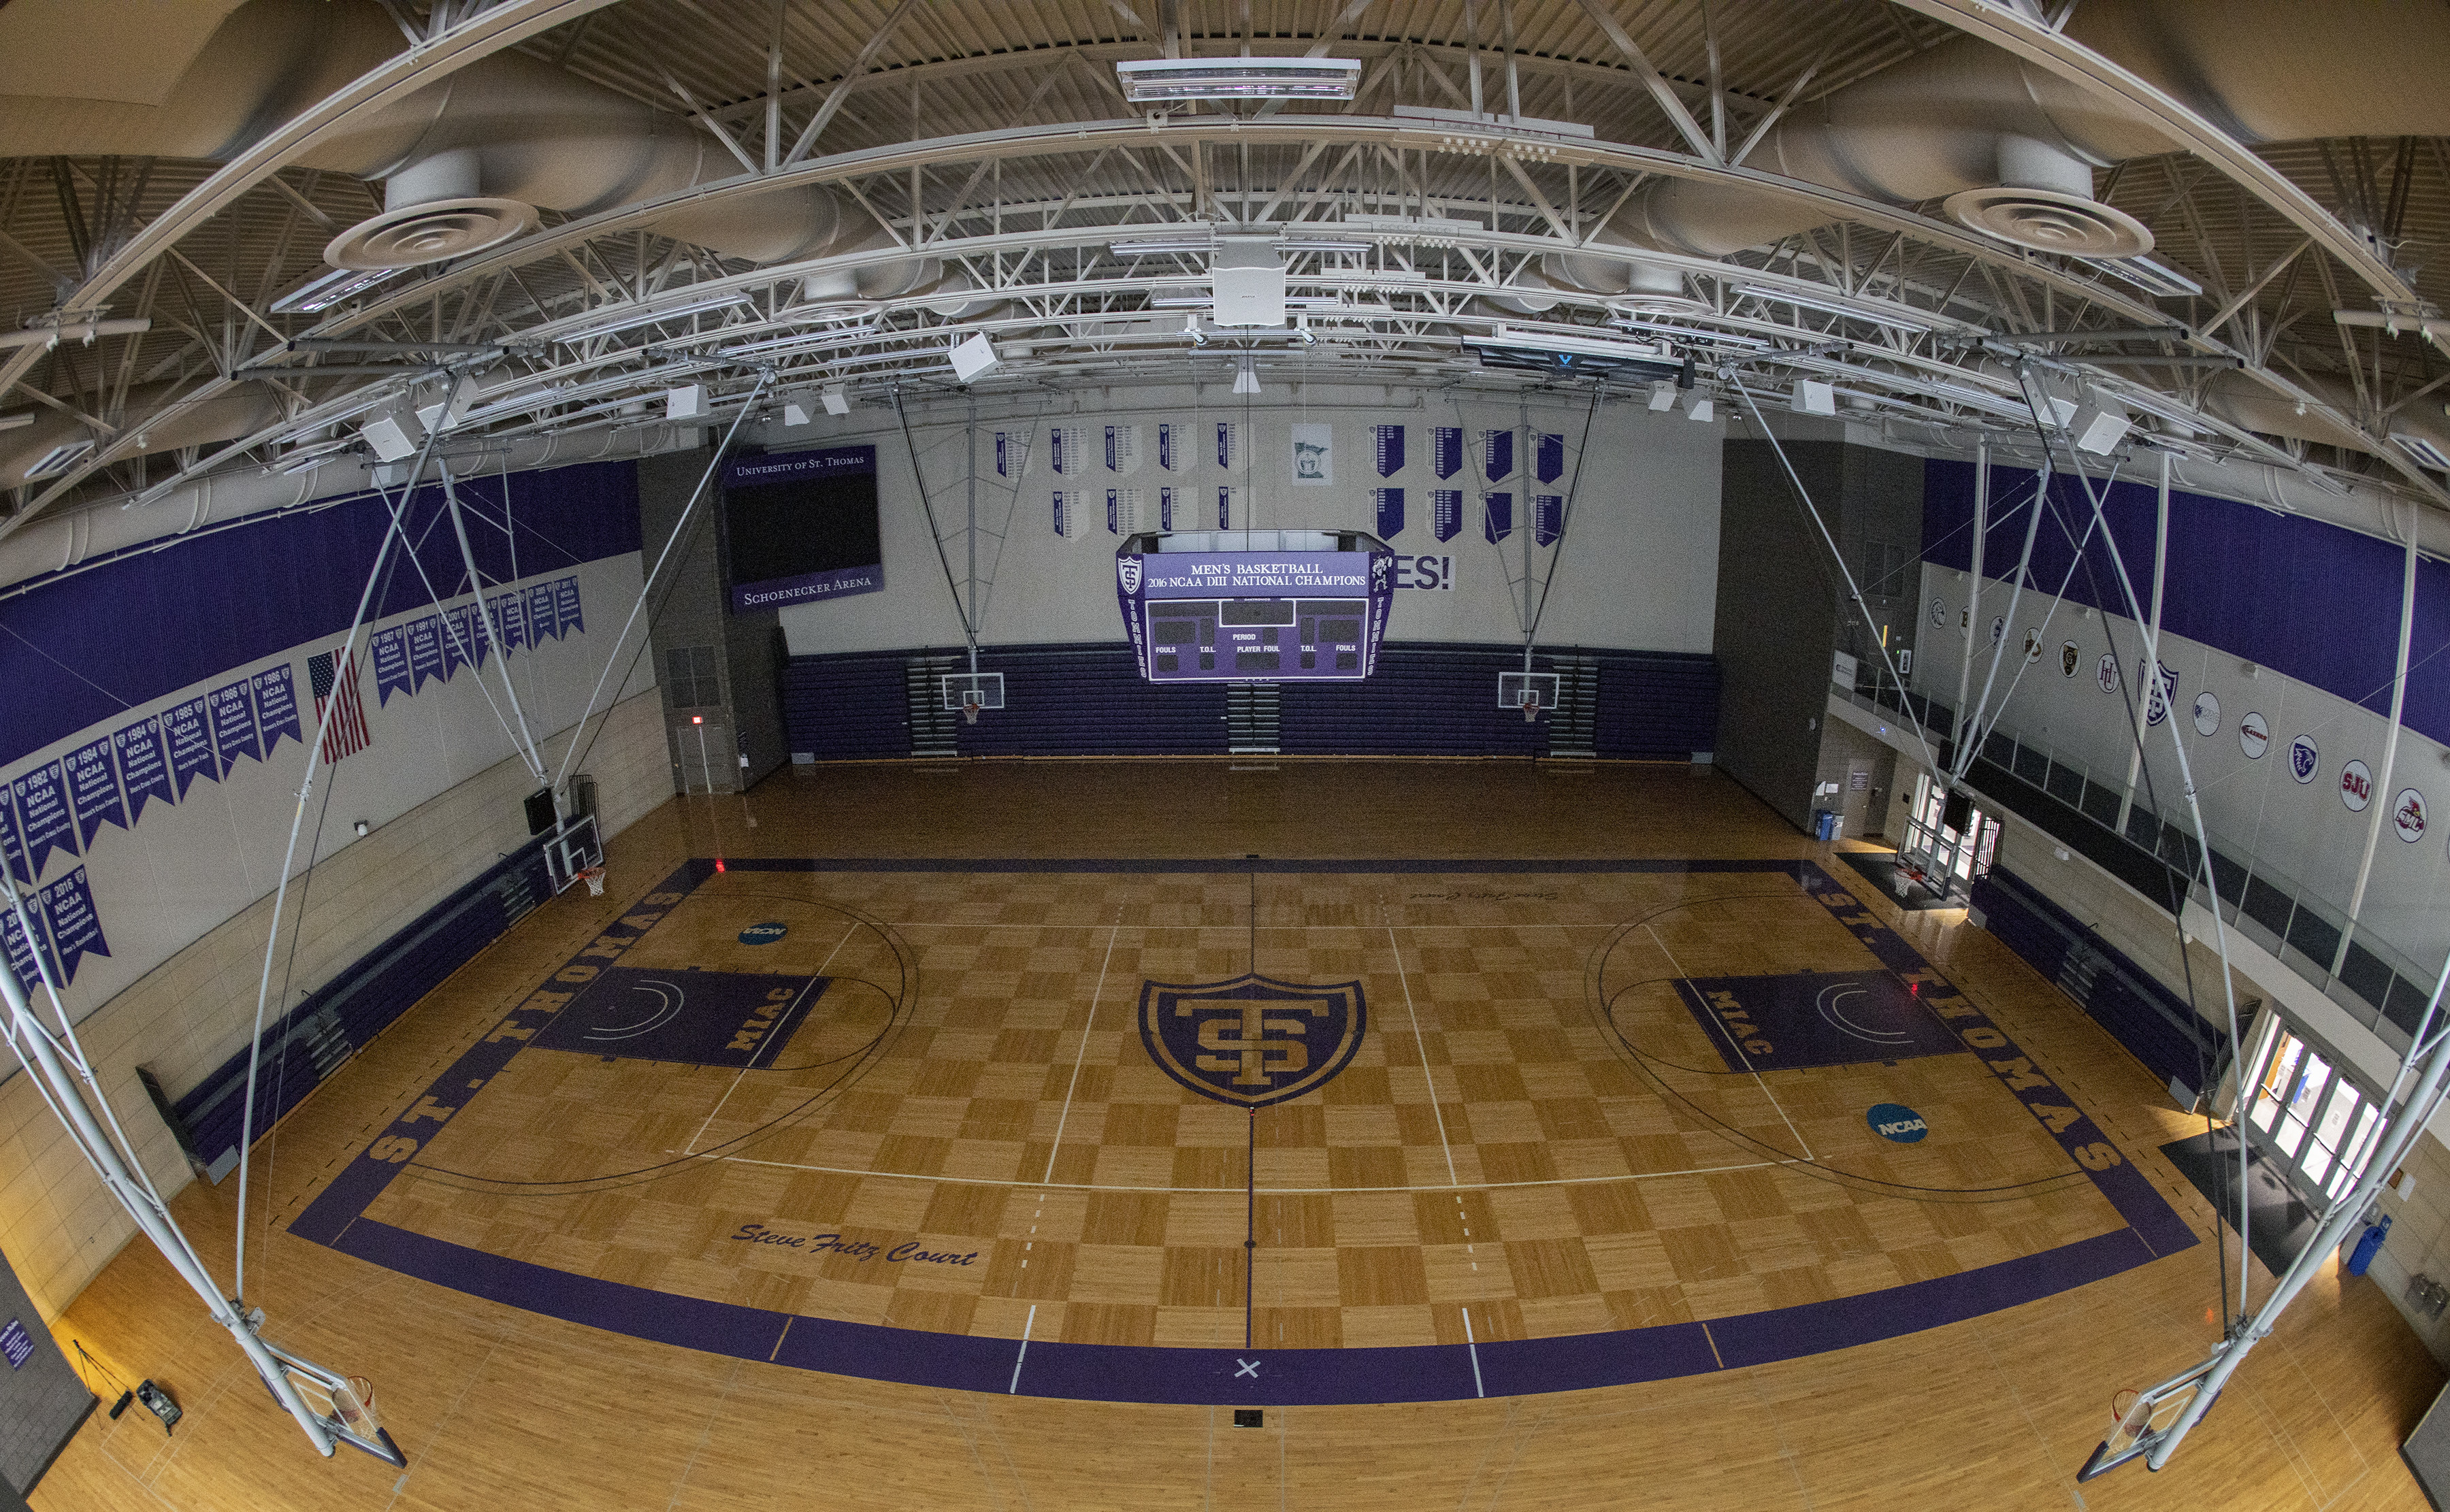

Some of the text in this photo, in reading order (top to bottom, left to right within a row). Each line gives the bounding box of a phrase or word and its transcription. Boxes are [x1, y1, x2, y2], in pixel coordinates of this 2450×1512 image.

[736, 464, 792, 476] UNIVERSITY
[809, 459, 823, 468] ST.
[826, 457, 864, 466] THOMAS
[1191, 564, 1323, 575] MEN'S BASKETBALL
[1148, 576, 1366, 587] 2016 NCAA DIII NATIONAL CHAMPIONS
[534, 595, 549, 605] NCAA
[744, 578, 872, 605] SCHOENECKER ARENA
[414, 632, 433, 644] NCAA
[1128, 599, 1147, 678] TOMMIES
[1367, 597, 1384, 675] TOMMIES
[379, 643, 399, 655] NCAA
[413, 649, 438, 660] Champions
[415, 641, 434, 651] National
[378, 660, 405, 673] Champions
[380, 652, 400, 663] National
[264, 671, 280, 686] 1986
[220, 687, 238, 702] 1986
[262, 684, 286, 700] NCAA
[264, 693, 288, 708] National
[175, 704, 193, 721] 1985
[219, 700, 244, 717] NCAA
[221, 710, 246, 726] National
[262, 703, 293, 719] Champions
[127, 725, 146, 742] 1984
[174, 718, 199, 736] NCAA
[219, 720, 251, 738] Champions
[176, 729, 202, 746] National
[78, 746, 98, 766] 1984
[126, 738, 153, 758] NCAA
[174, 740, 208, 759] Champions
[128, 750, 156, 768] National
[28, 770, 48, 790] 1982
[76, 761, 105, 782] NCAA
[127, 761, 162, 780] Champions
[79, 772, 108, 792] National
[2342, 771, 2370, 801] SJU
[27, 785, 56, 808] NCAA
[78, 783, 114, 805] Champions
[29, 798, 59, 819] National
[28, 808, 65, 832] Champions
[54, 878, 74, 898] 2016
[54, 892, 82, 915] NCAA
[57, 904, 86, 927] National
[57, 913, 94, 940] Champions
[370, 892, 683, 1164] ST. THOMAS
[725, 988, 794, 1051] MIAC
[1706, 991, 1774, 1054] MIAC
[1818, 893, 2122, 1172] ST. THOMAS
[1878, 1119, 1927, 1136] NCAA
[731, 1224, 979, 1266] Steve Fritz Court
